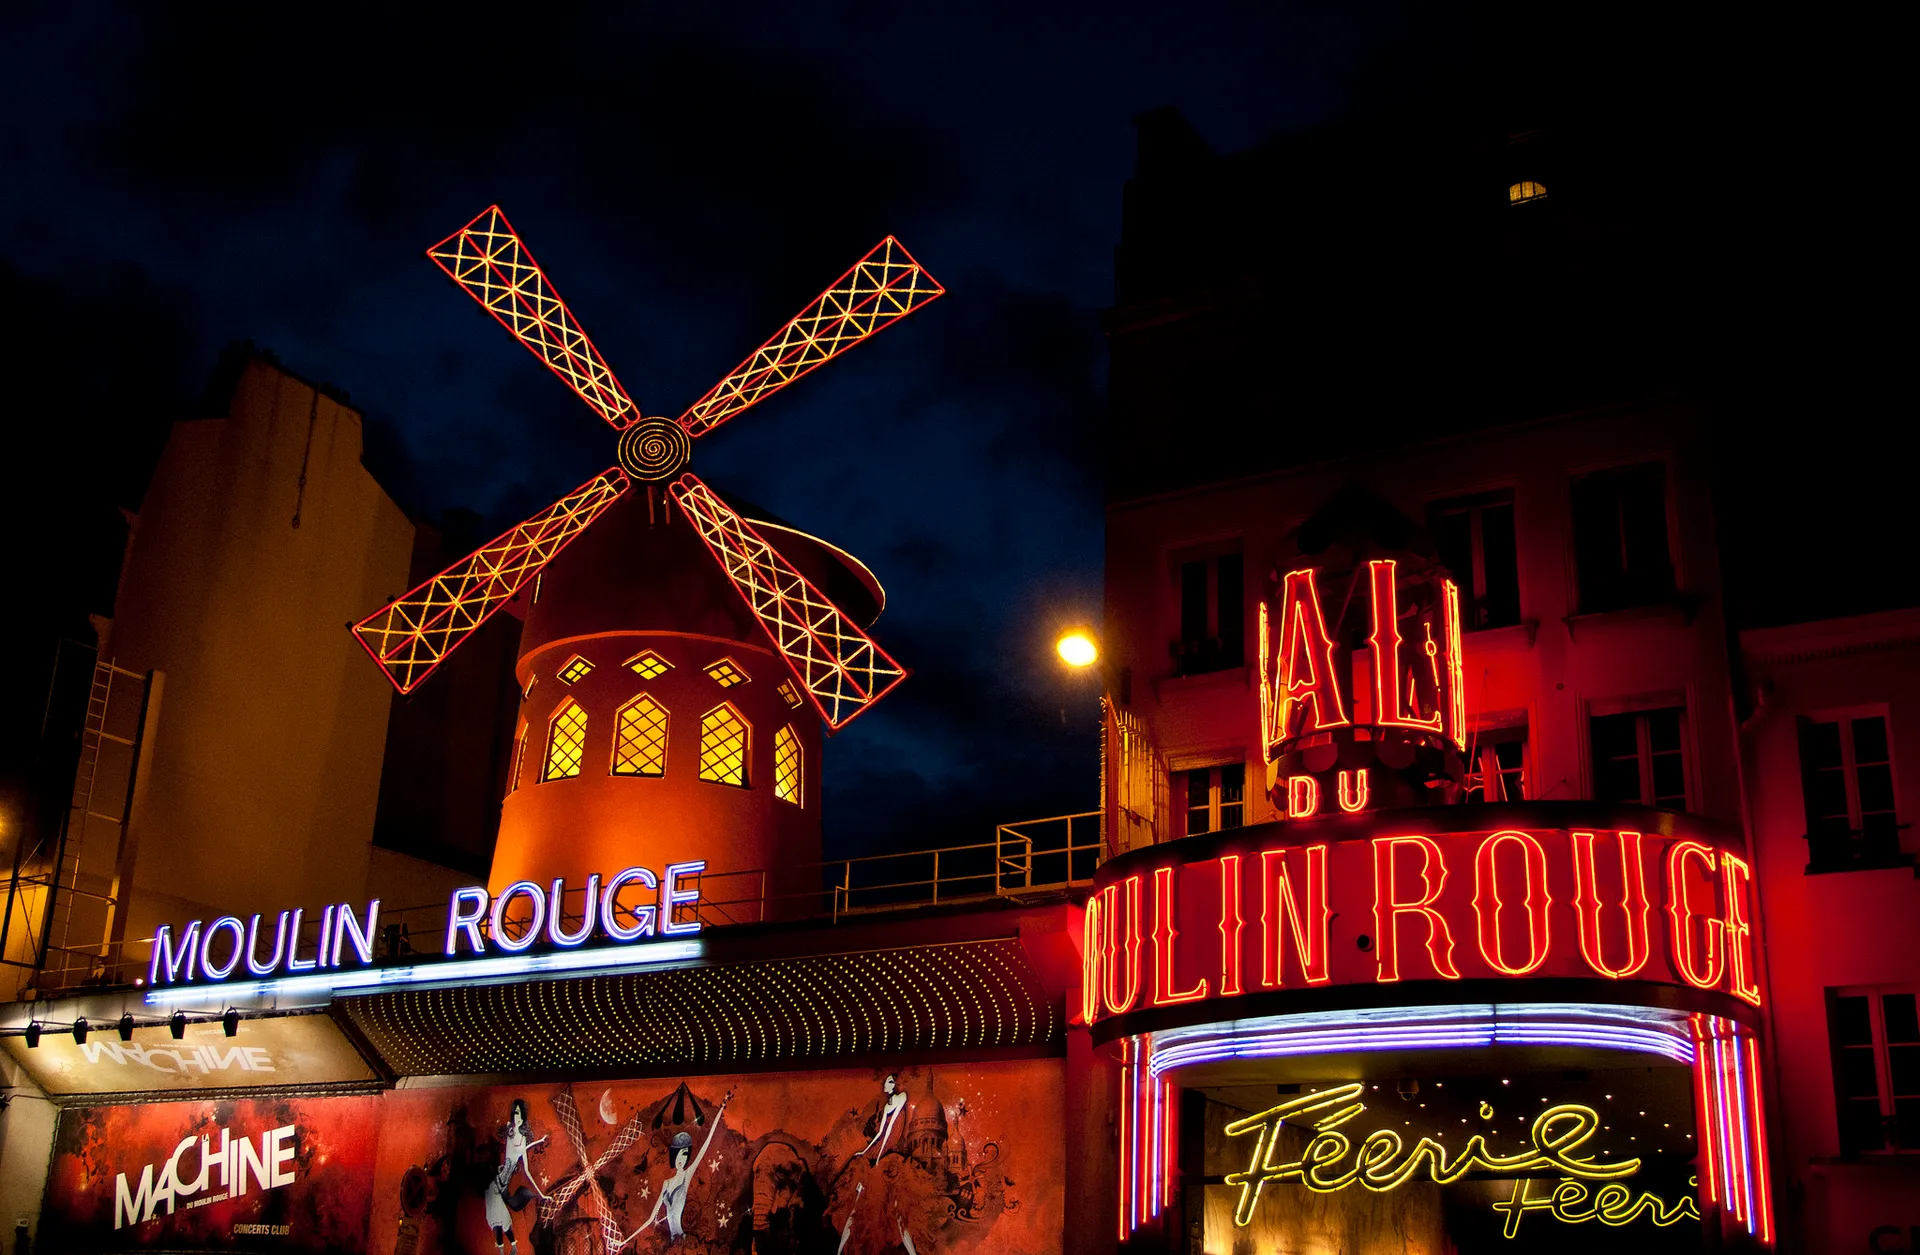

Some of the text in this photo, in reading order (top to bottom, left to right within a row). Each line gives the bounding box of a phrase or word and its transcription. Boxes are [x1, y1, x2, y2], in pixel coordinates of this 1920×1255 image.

[1289, 770, 1369, 818] DU
[149, 859, 708, 983] MOULIN ROUGE
[1083, 830, 1761, 1025] OULIN ROUGE
[114, 1125, 295, 1230] MACHINE
[194, 1197, 212, 1207] MOULIN
[212, 1192, 228, 1202] ROUGE
[1225, 1083, 1640, 1226] Féerie
[233, 1223, 290, 1235] CONCERTS CLUB
